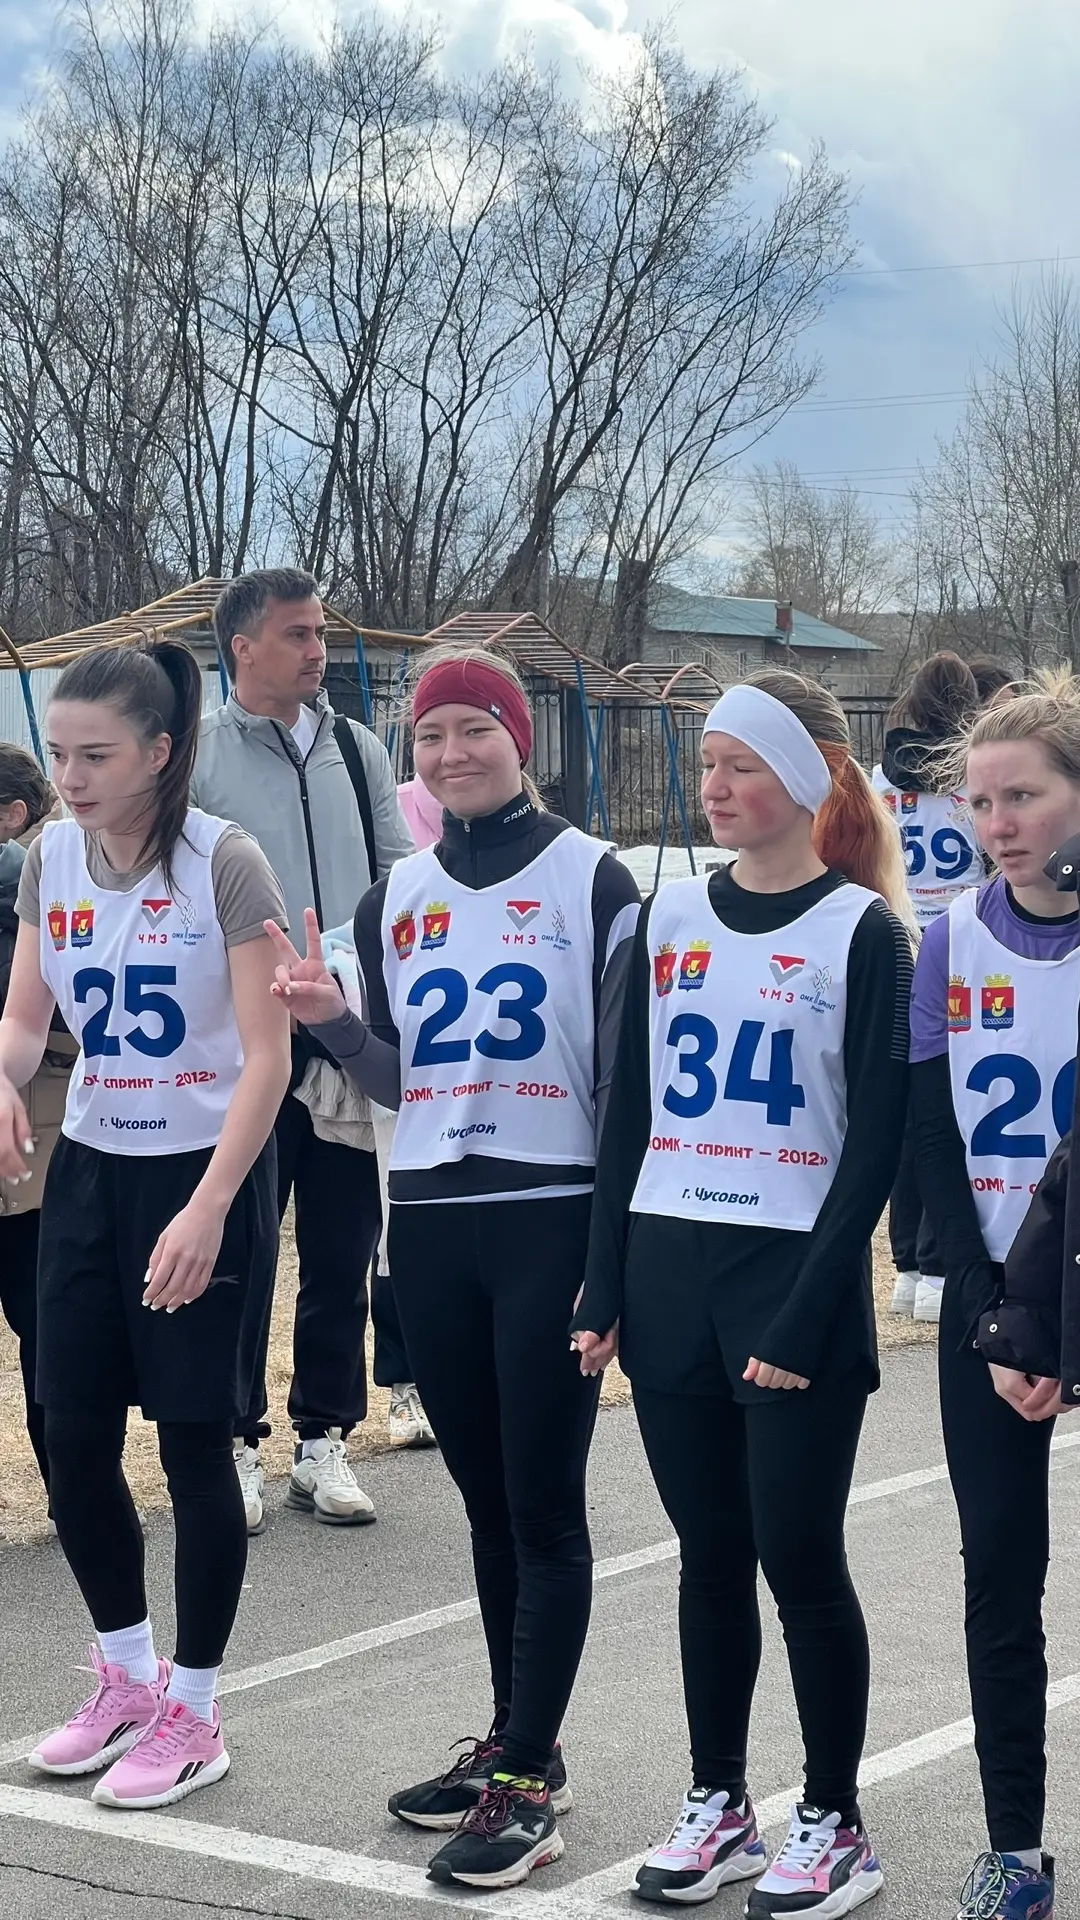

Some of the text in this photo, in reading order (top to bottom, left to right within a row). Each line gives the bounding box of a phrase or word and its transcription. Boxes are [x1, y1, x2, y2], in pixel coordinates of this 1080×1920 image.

[503, 802, 531, 823] CRAFT
[900, 826, 974, 880] 59
[138, 933, 168, 945] ЧМЗ
[502, 934, 537, 945] ЧМЗ
[760, 987, 795, 1004] ЧМЗ
[72, 964, 187, 1059] 25
[405, 963, 548, 1068] 23
[662, 1013, 806, 1127] 34
[104, 1078, 154, 1090] спринт
[403, 1086, 434, 1103] ОМК
[452, 1081, 493, 1098] спринт
[100, 1116, 167, 1130] г. Чусовой
[696, 1143, 754, 1159] спринт
[777, 1148, 828, 1167] 2012»
[682, 1187, 760, 1206] г. Чусовой
